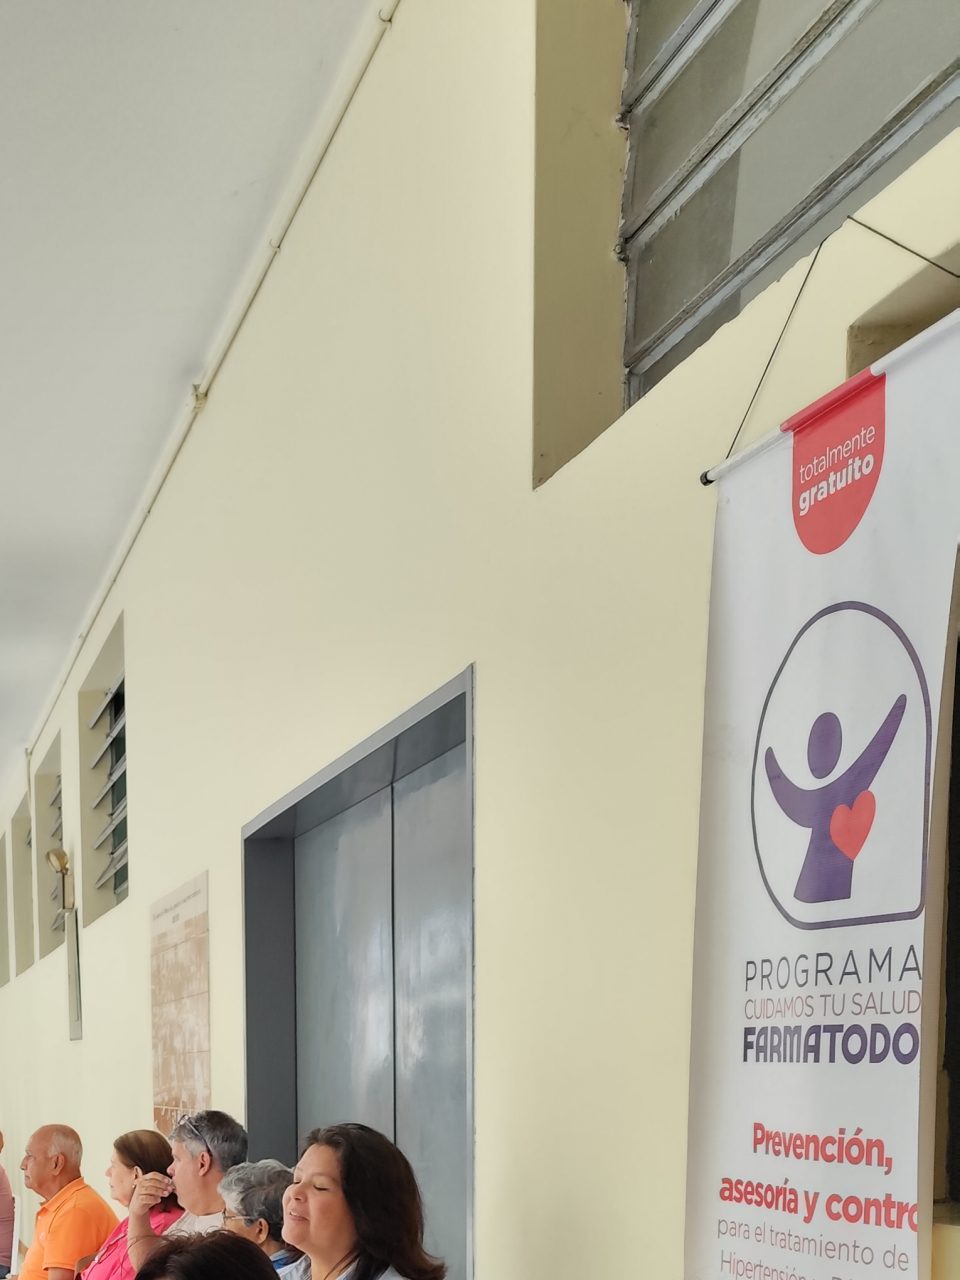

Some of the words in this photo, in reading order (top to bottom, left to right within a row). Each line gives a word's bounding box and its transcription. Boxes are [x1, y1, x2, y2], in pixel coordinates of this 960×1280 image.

[799, 425, 876, 484] totalmente
[798, 453, 874, 517] gratuito
[745, 944, 922, 992] PROGRAMA
[744, 995, 814, 1020] CUIDAMOS
[820, 992, 845, 1017] TU
[851, 989, 922, 1016] SALUD
[742, 1022, 920, 1065] FARMATODO
[753, 1122, 893, 1175] Prevención,
[719, 1177, 798, 1215] asesoría
[803, 1191, 820, 1224] y
[717, 1218, 750, 1240] para
[754, 1221, 766, 1244] el
[769, 1224, 875, 1266] tratamiento
[882, 1243, 909, 1272] de
